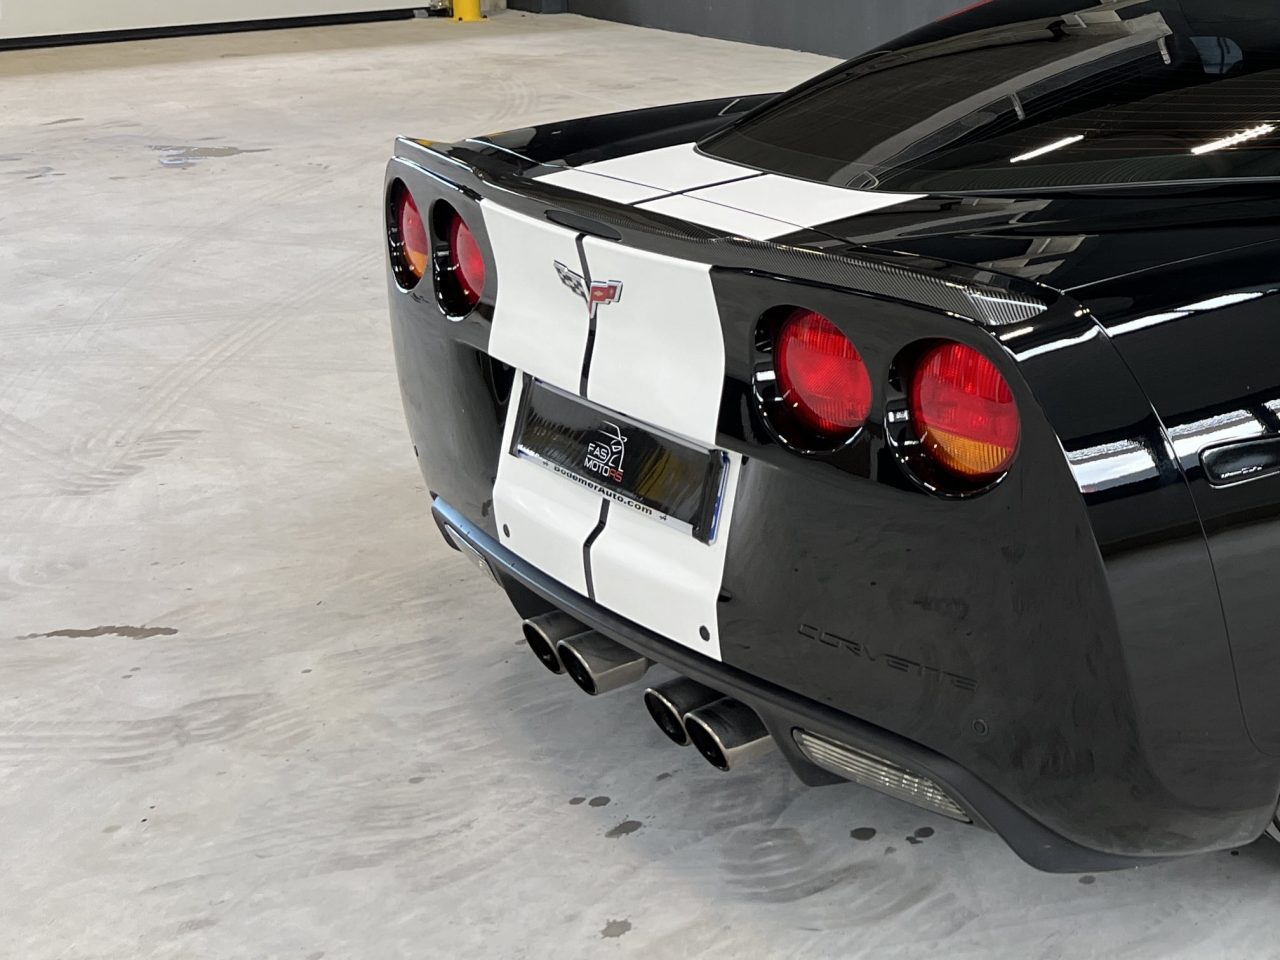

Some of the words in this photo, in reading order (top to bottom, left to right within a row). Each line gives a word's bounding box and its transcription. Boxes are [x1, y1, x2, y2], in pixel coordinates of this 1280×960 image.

[587, 442, 608, 460] FAS
[584, 456, 624, 482] MOTORS
[798, 623, 978, 692] CORVETTE
